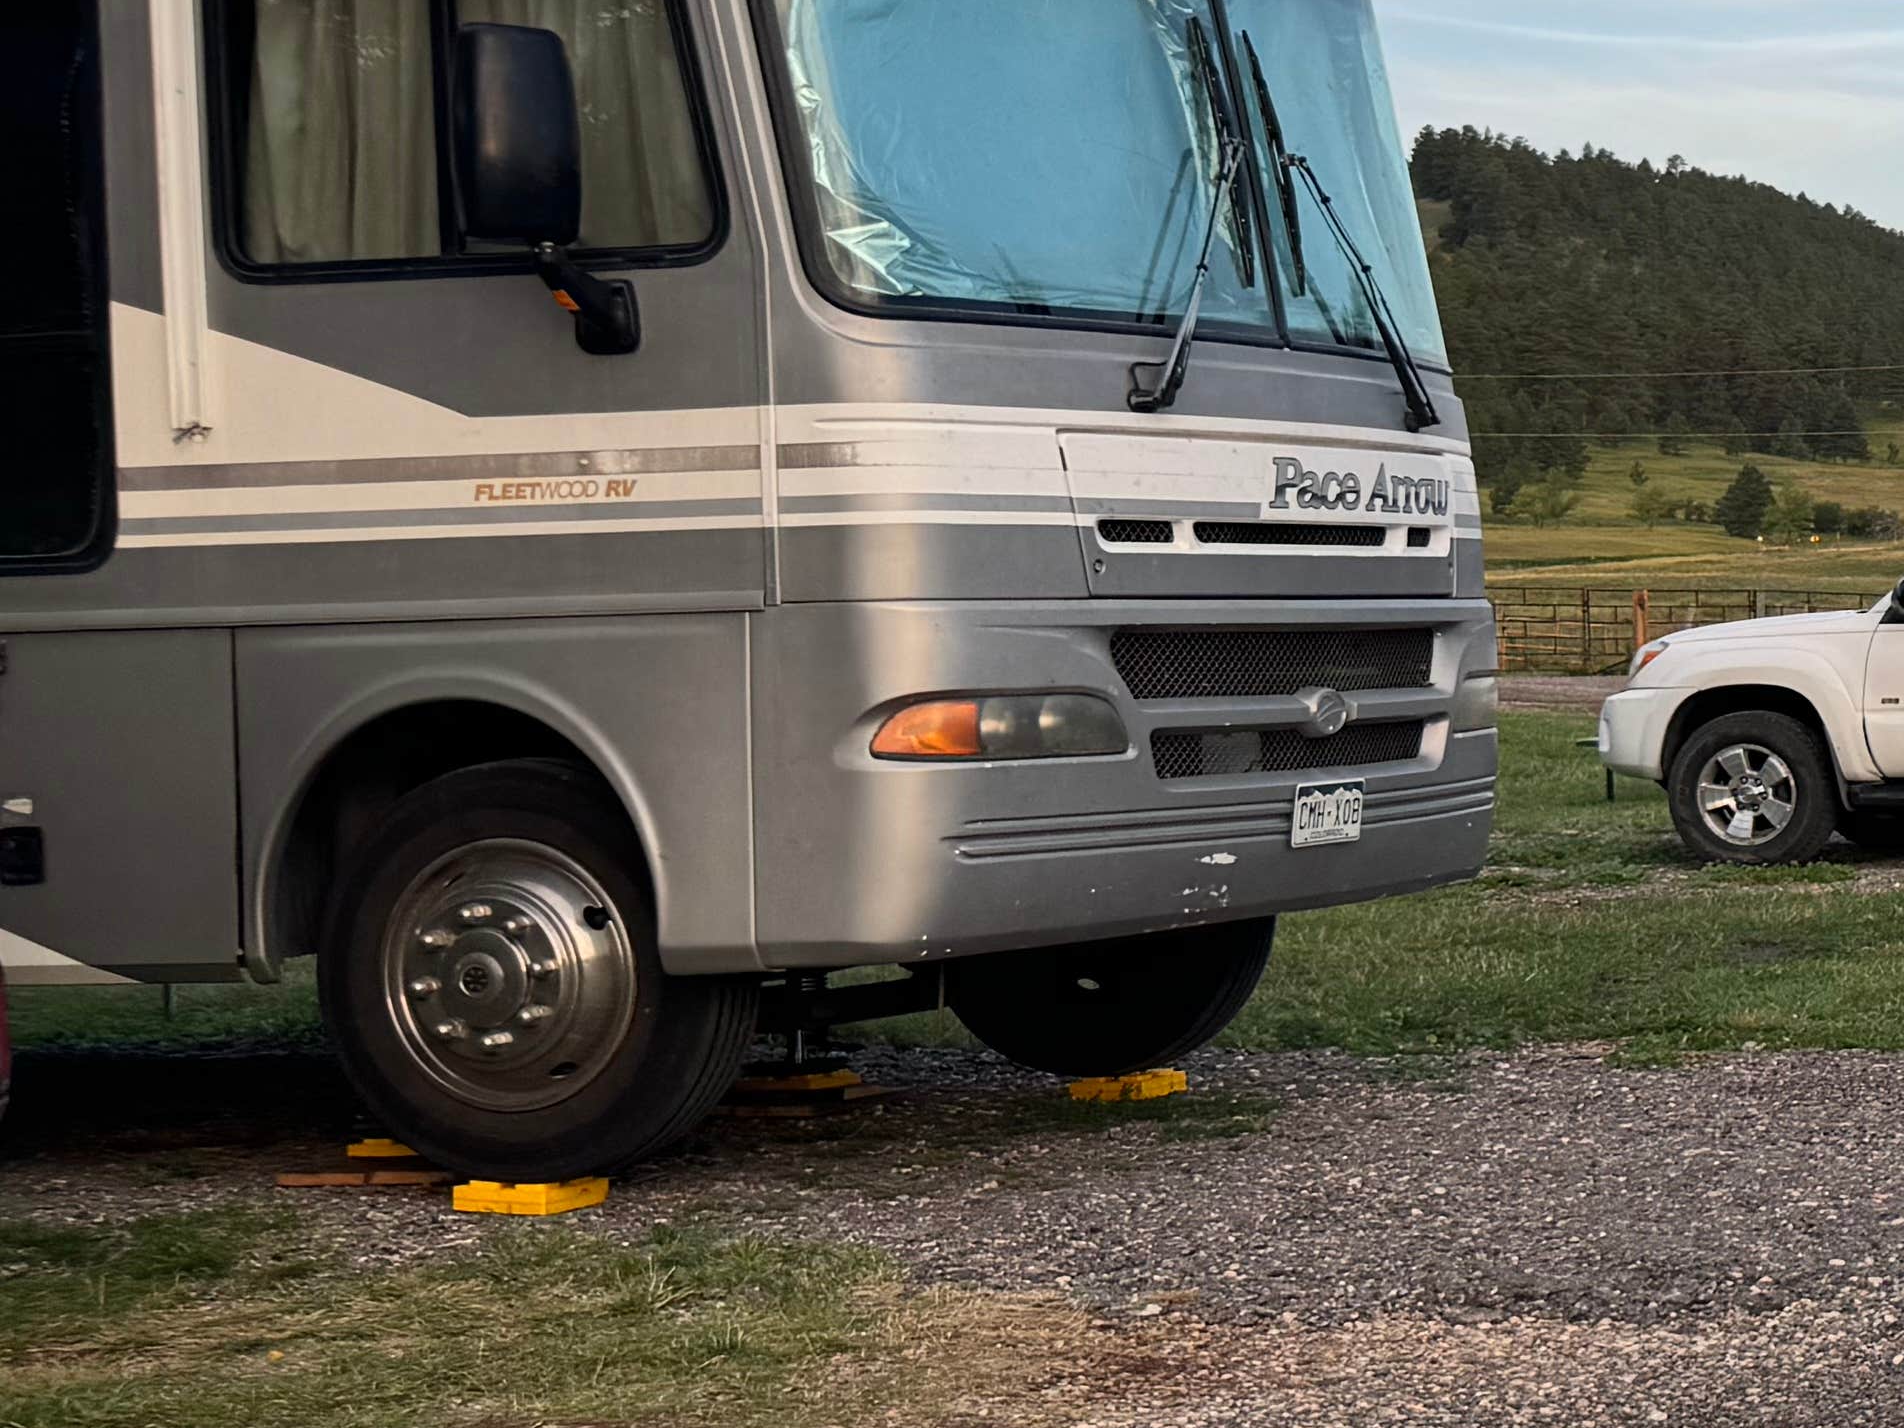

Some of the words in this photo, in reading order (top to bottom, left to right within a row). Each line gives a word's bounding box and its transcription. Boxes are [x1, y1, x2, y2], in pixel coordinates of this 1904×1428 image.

[474, 480, 599, 501] FLEETWOOD
[604, 479, 638, 498] RV
[1269, 456, 1361, 510] Pace
[1365, 462, 1450, 516] Arrow
